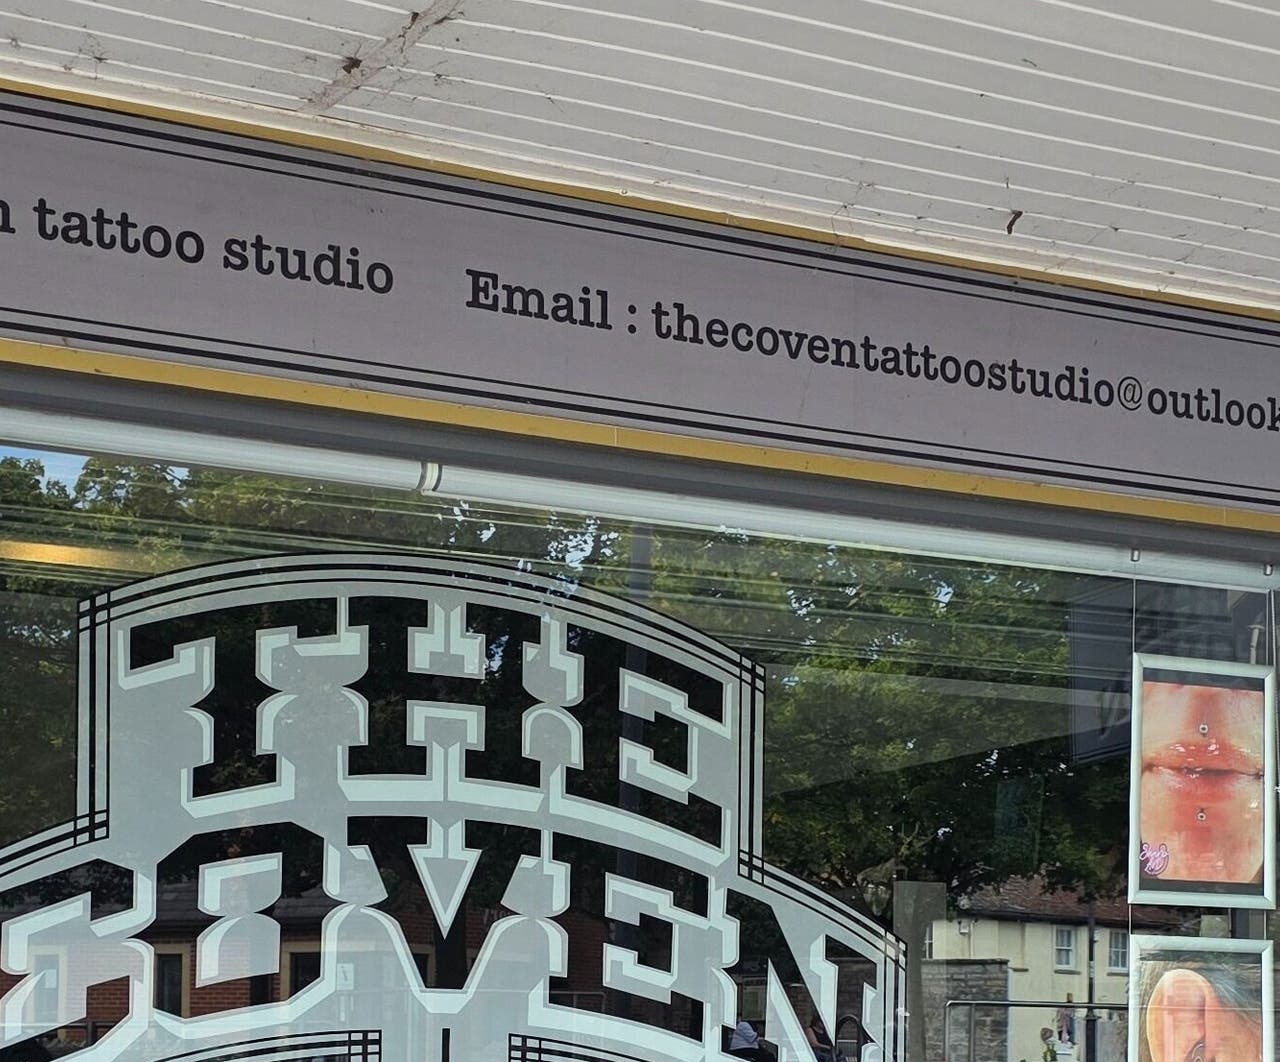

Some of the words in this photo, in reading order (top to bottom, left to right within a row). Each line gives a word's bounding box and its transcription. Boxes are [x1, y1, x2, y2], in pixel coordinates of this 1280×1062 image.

[33, 198, 205, 265] tattoo
[222, 233, 395, 295] studio
[465, 268, 613, 333] Email
[119, 596, 731, 859] THE
